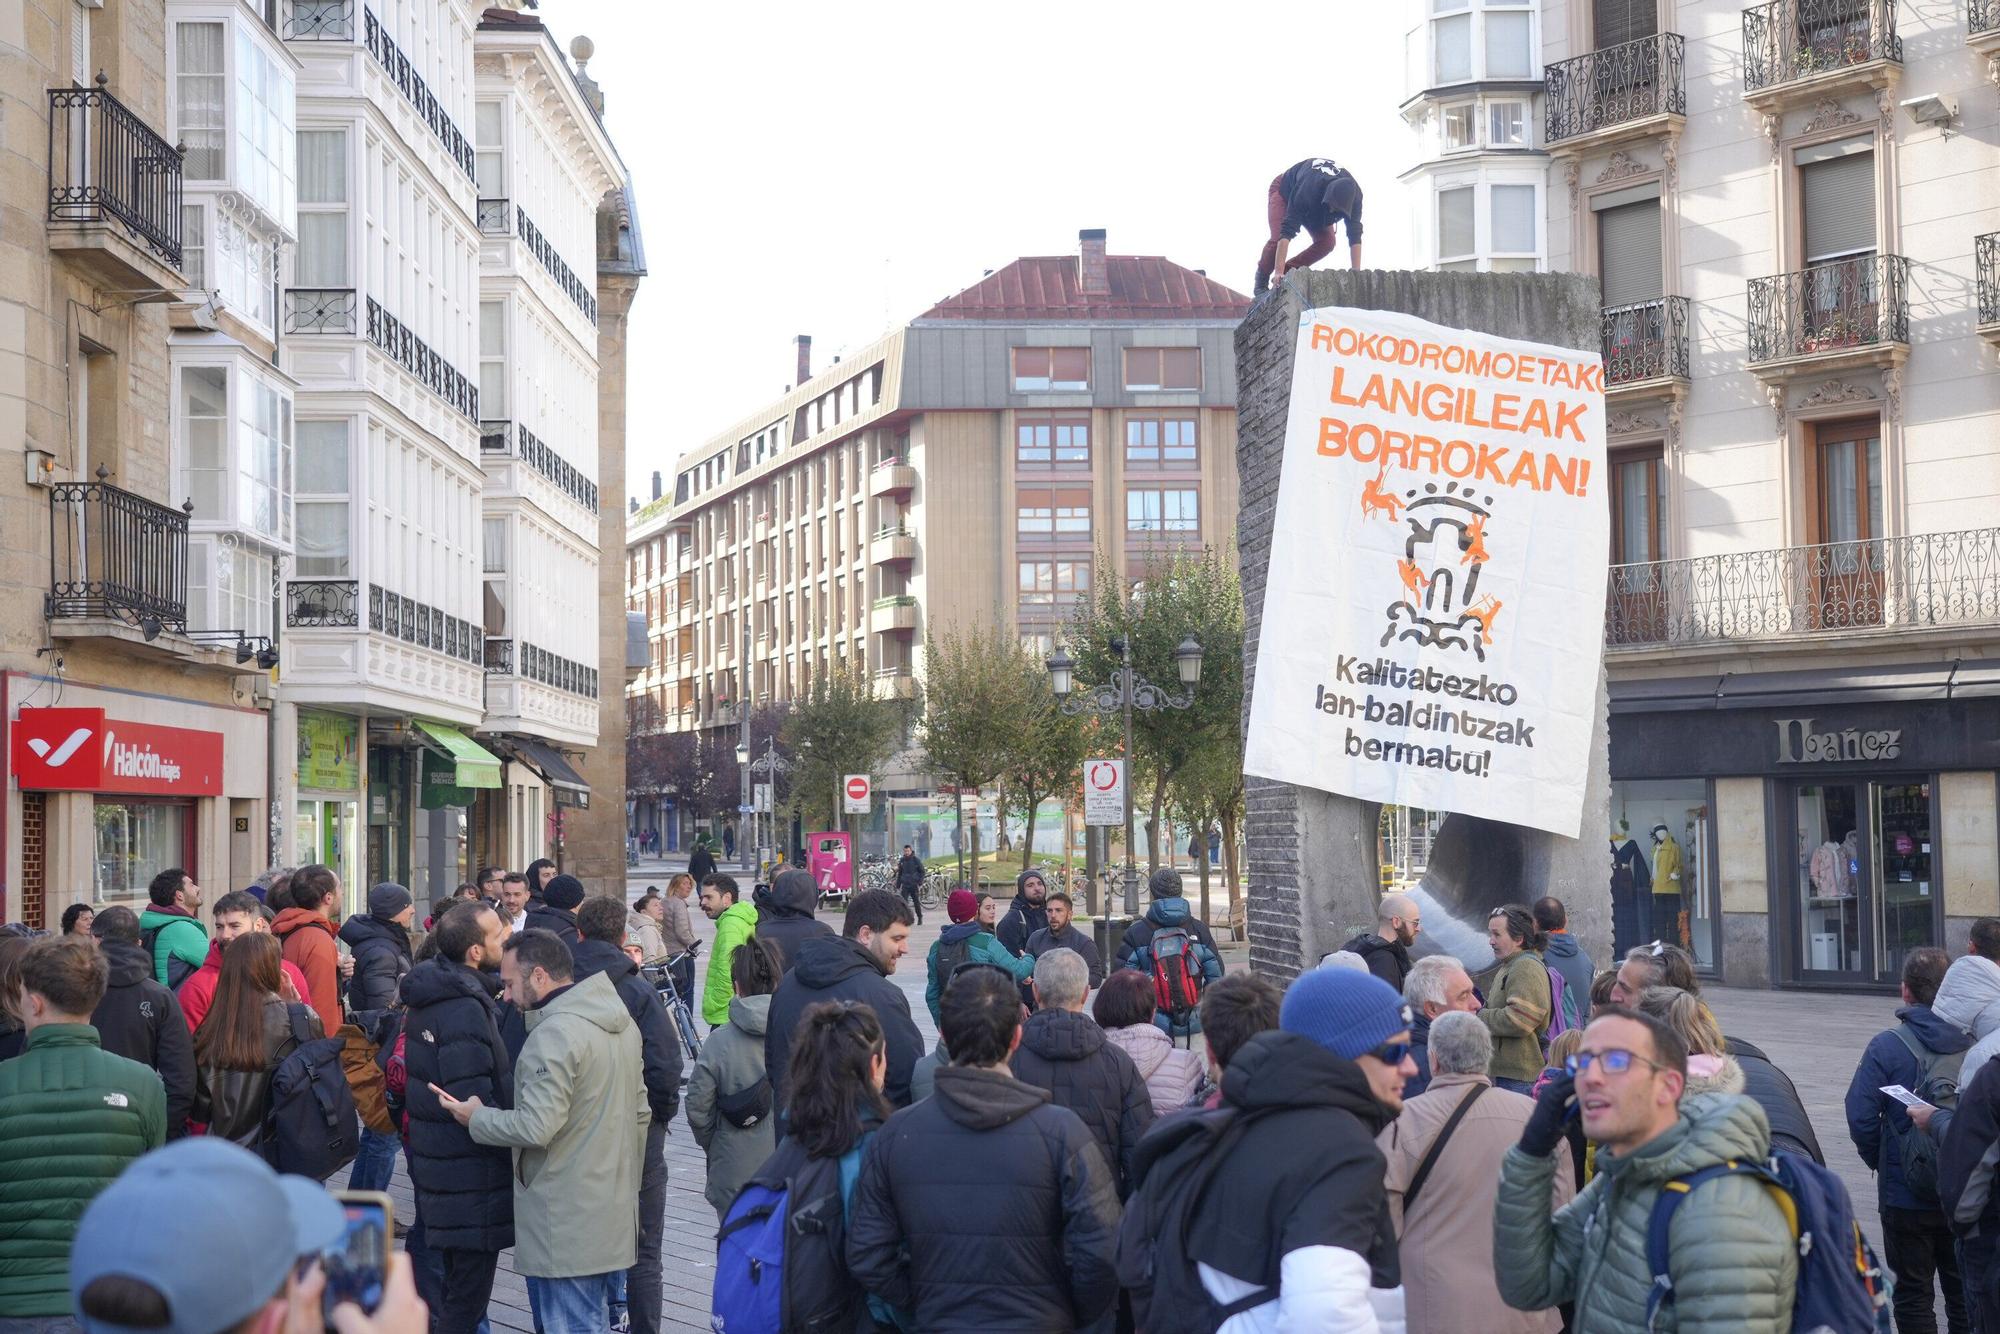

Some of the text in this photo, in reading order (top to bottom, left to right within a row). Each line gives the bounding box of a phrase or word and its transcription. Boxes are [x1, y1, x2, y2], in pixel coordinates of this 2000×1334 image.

[1331, 367, 1587, 442] LANGILEAK
[1317, 417, 1591, 496] BORROKAN!
[1336, 654, 1518, 706] Kalitatezko
[1315, 684, 1535, 748] lan-baldintzak
[113, 742, 181, 783] Halcón viajes
[1345, 727, 1491, 778] bermatu!
[237, 819, 247, 831] 3
